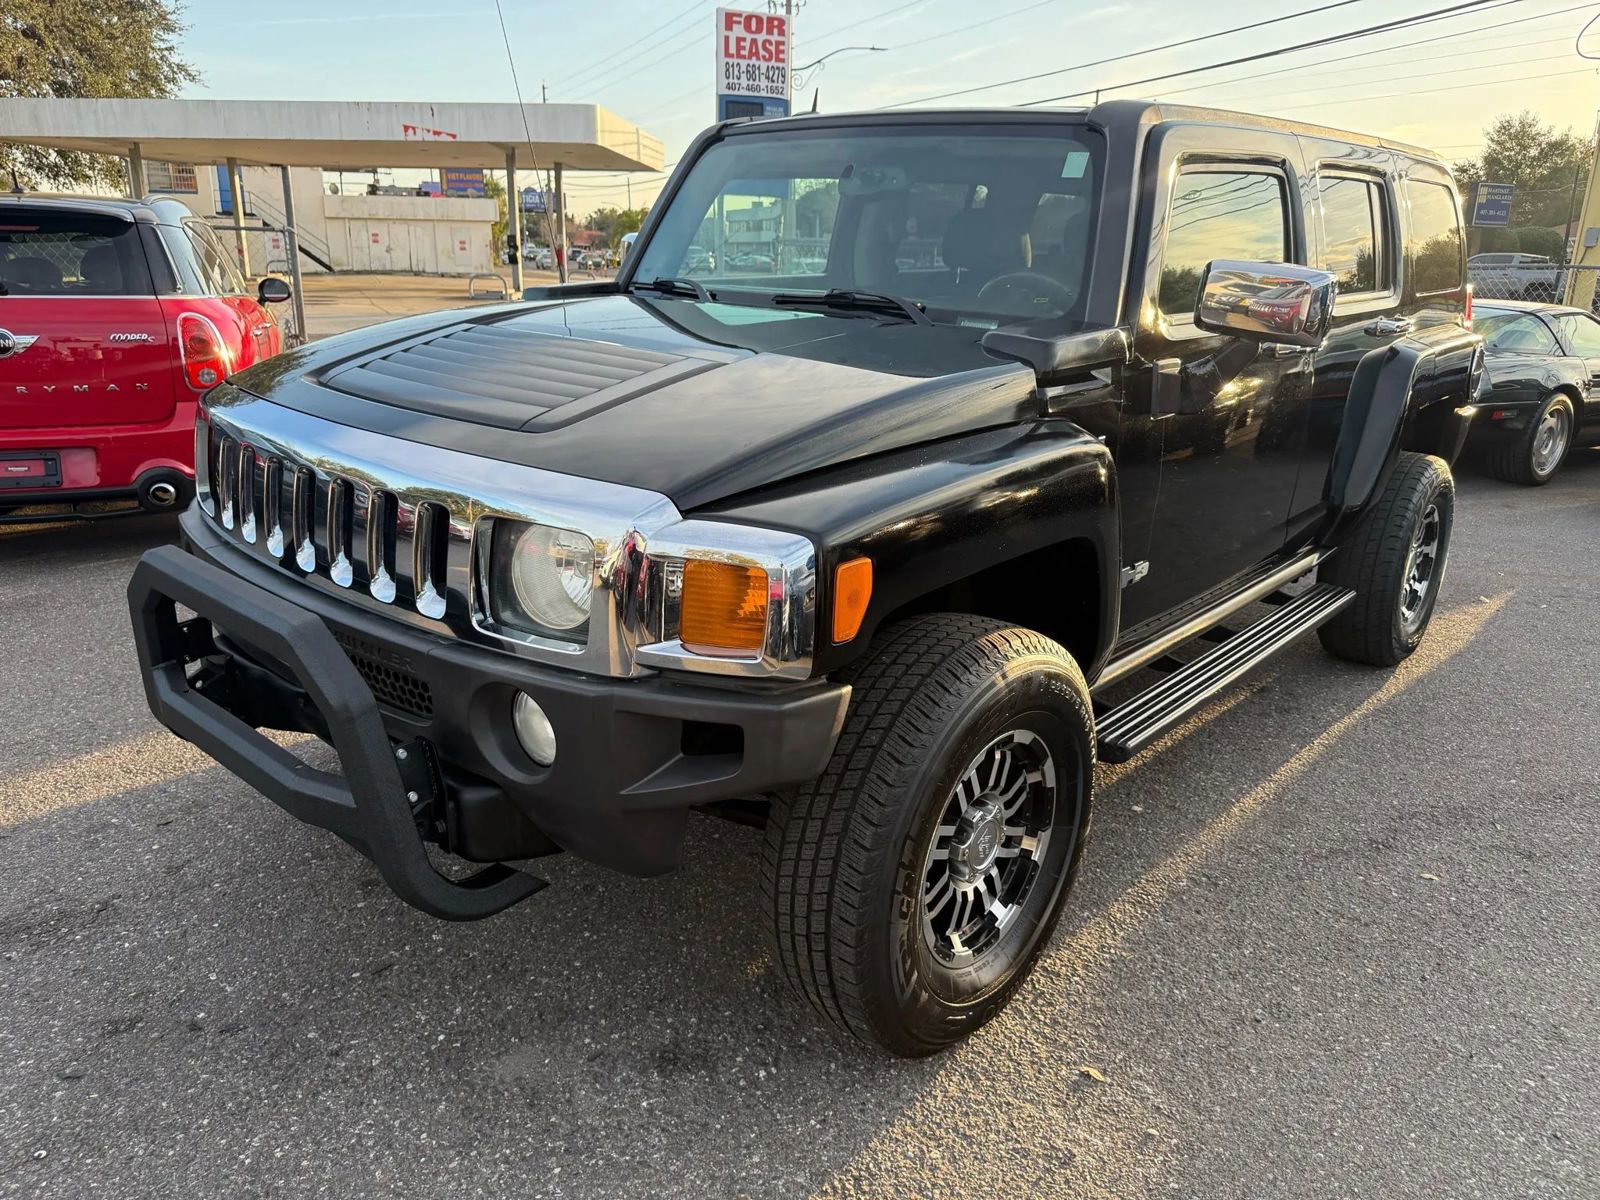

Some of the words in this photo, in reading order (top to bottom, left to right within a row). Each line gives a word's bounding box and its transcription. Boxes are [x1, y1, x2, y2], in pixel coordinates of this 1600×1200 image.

[724, 11, 786, 37] FOR
[723, 35, 786, 63] LEASE
[724, 61, 787, 85] 813-681-4279
[725, 81, 785, 96] 407-460-1652
[110, 333, 148, 342] COOPER
[15, 383, 149, 394] RYMAN
